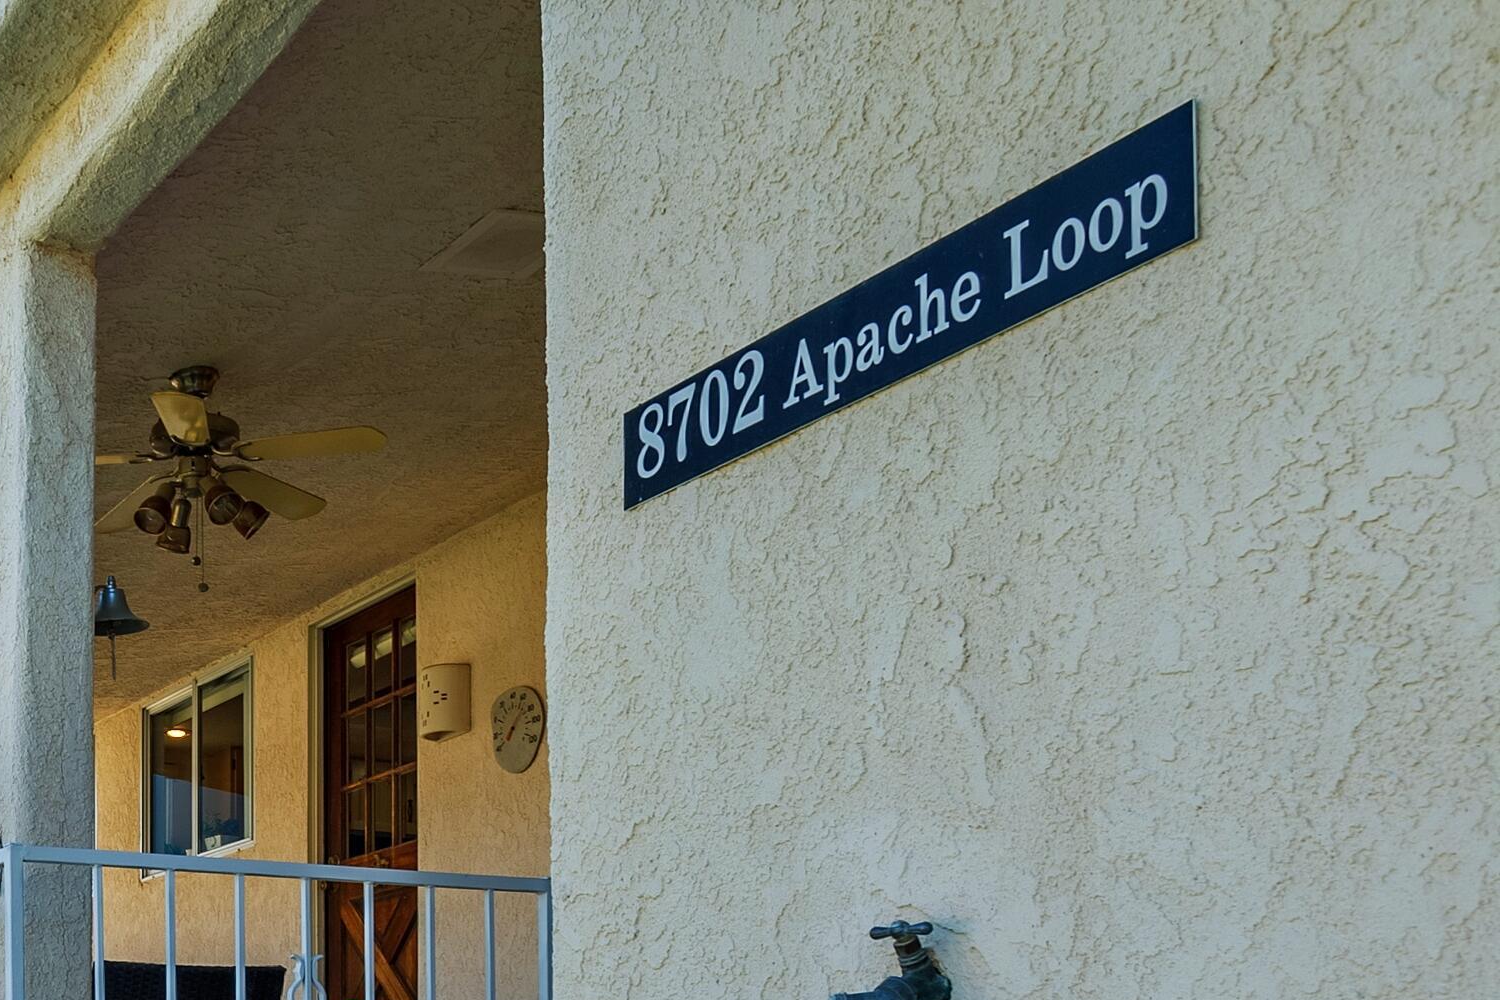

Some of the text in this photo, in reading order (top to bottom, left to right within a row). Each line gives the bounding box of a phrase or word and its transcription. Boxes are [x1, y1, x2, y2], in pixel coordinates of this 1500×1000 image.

[637, 173, 1168, 480] 8702 Apache Loop
